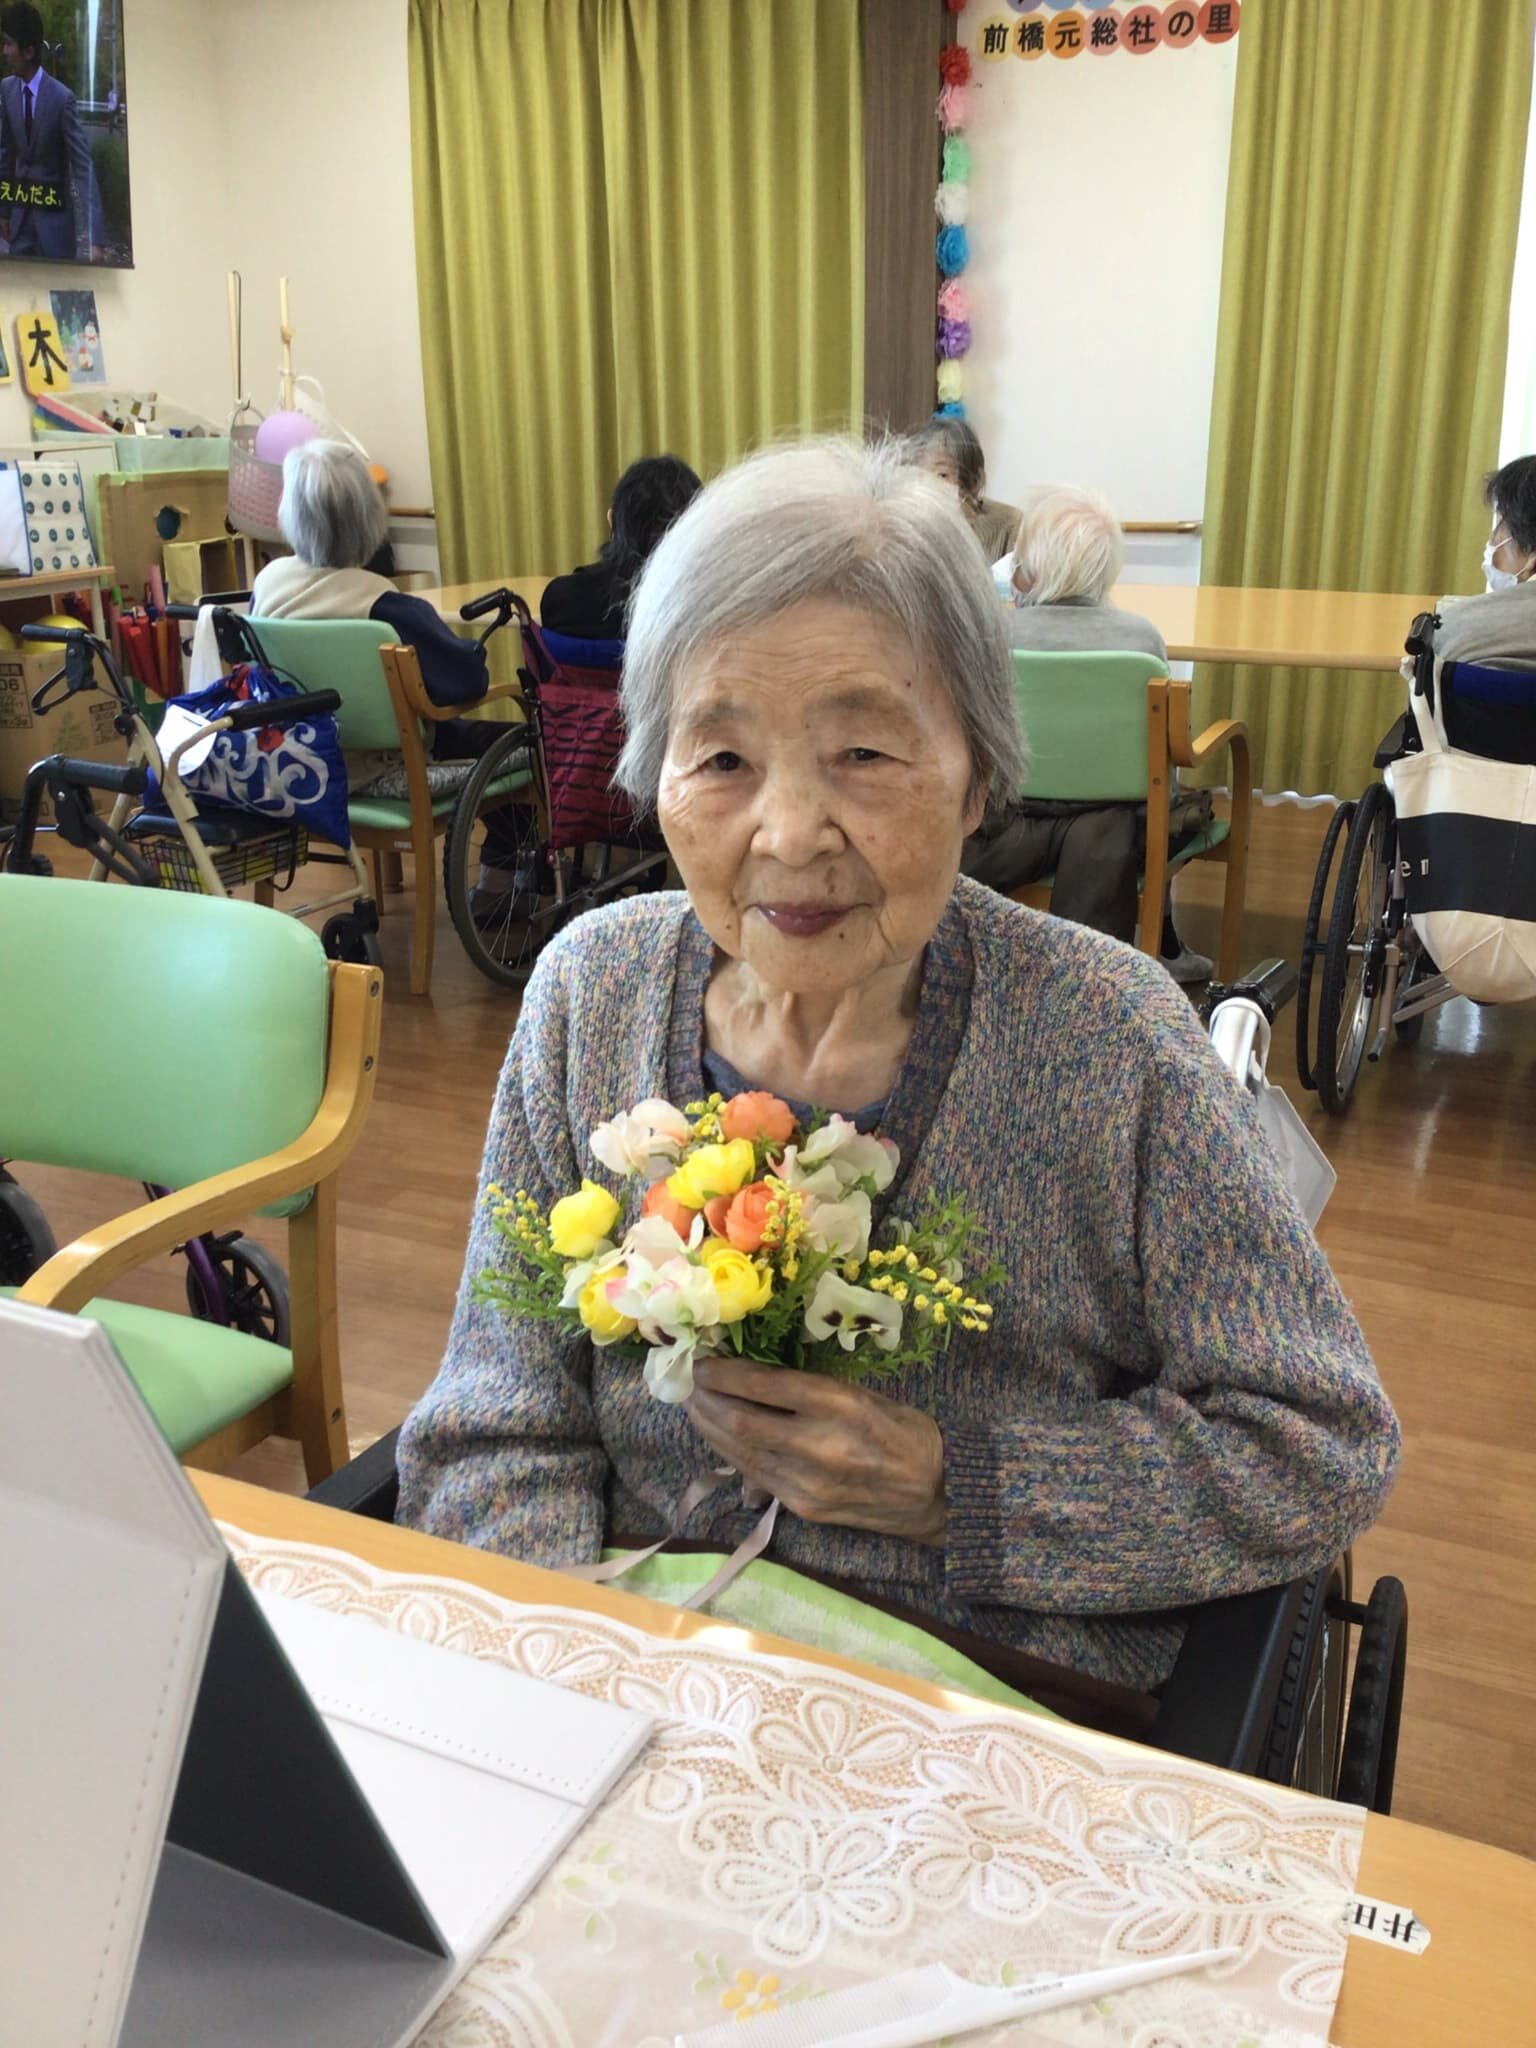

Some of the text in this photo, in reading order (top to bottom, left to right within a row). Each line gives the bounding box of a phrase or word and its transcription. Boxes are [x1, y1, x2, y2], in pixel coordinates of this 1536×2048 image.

[983, 3, 1233, 54] 前橋元総社の里
[0, 181, 57, 206] えんだよ
[28, 318, 68, 386] 木
